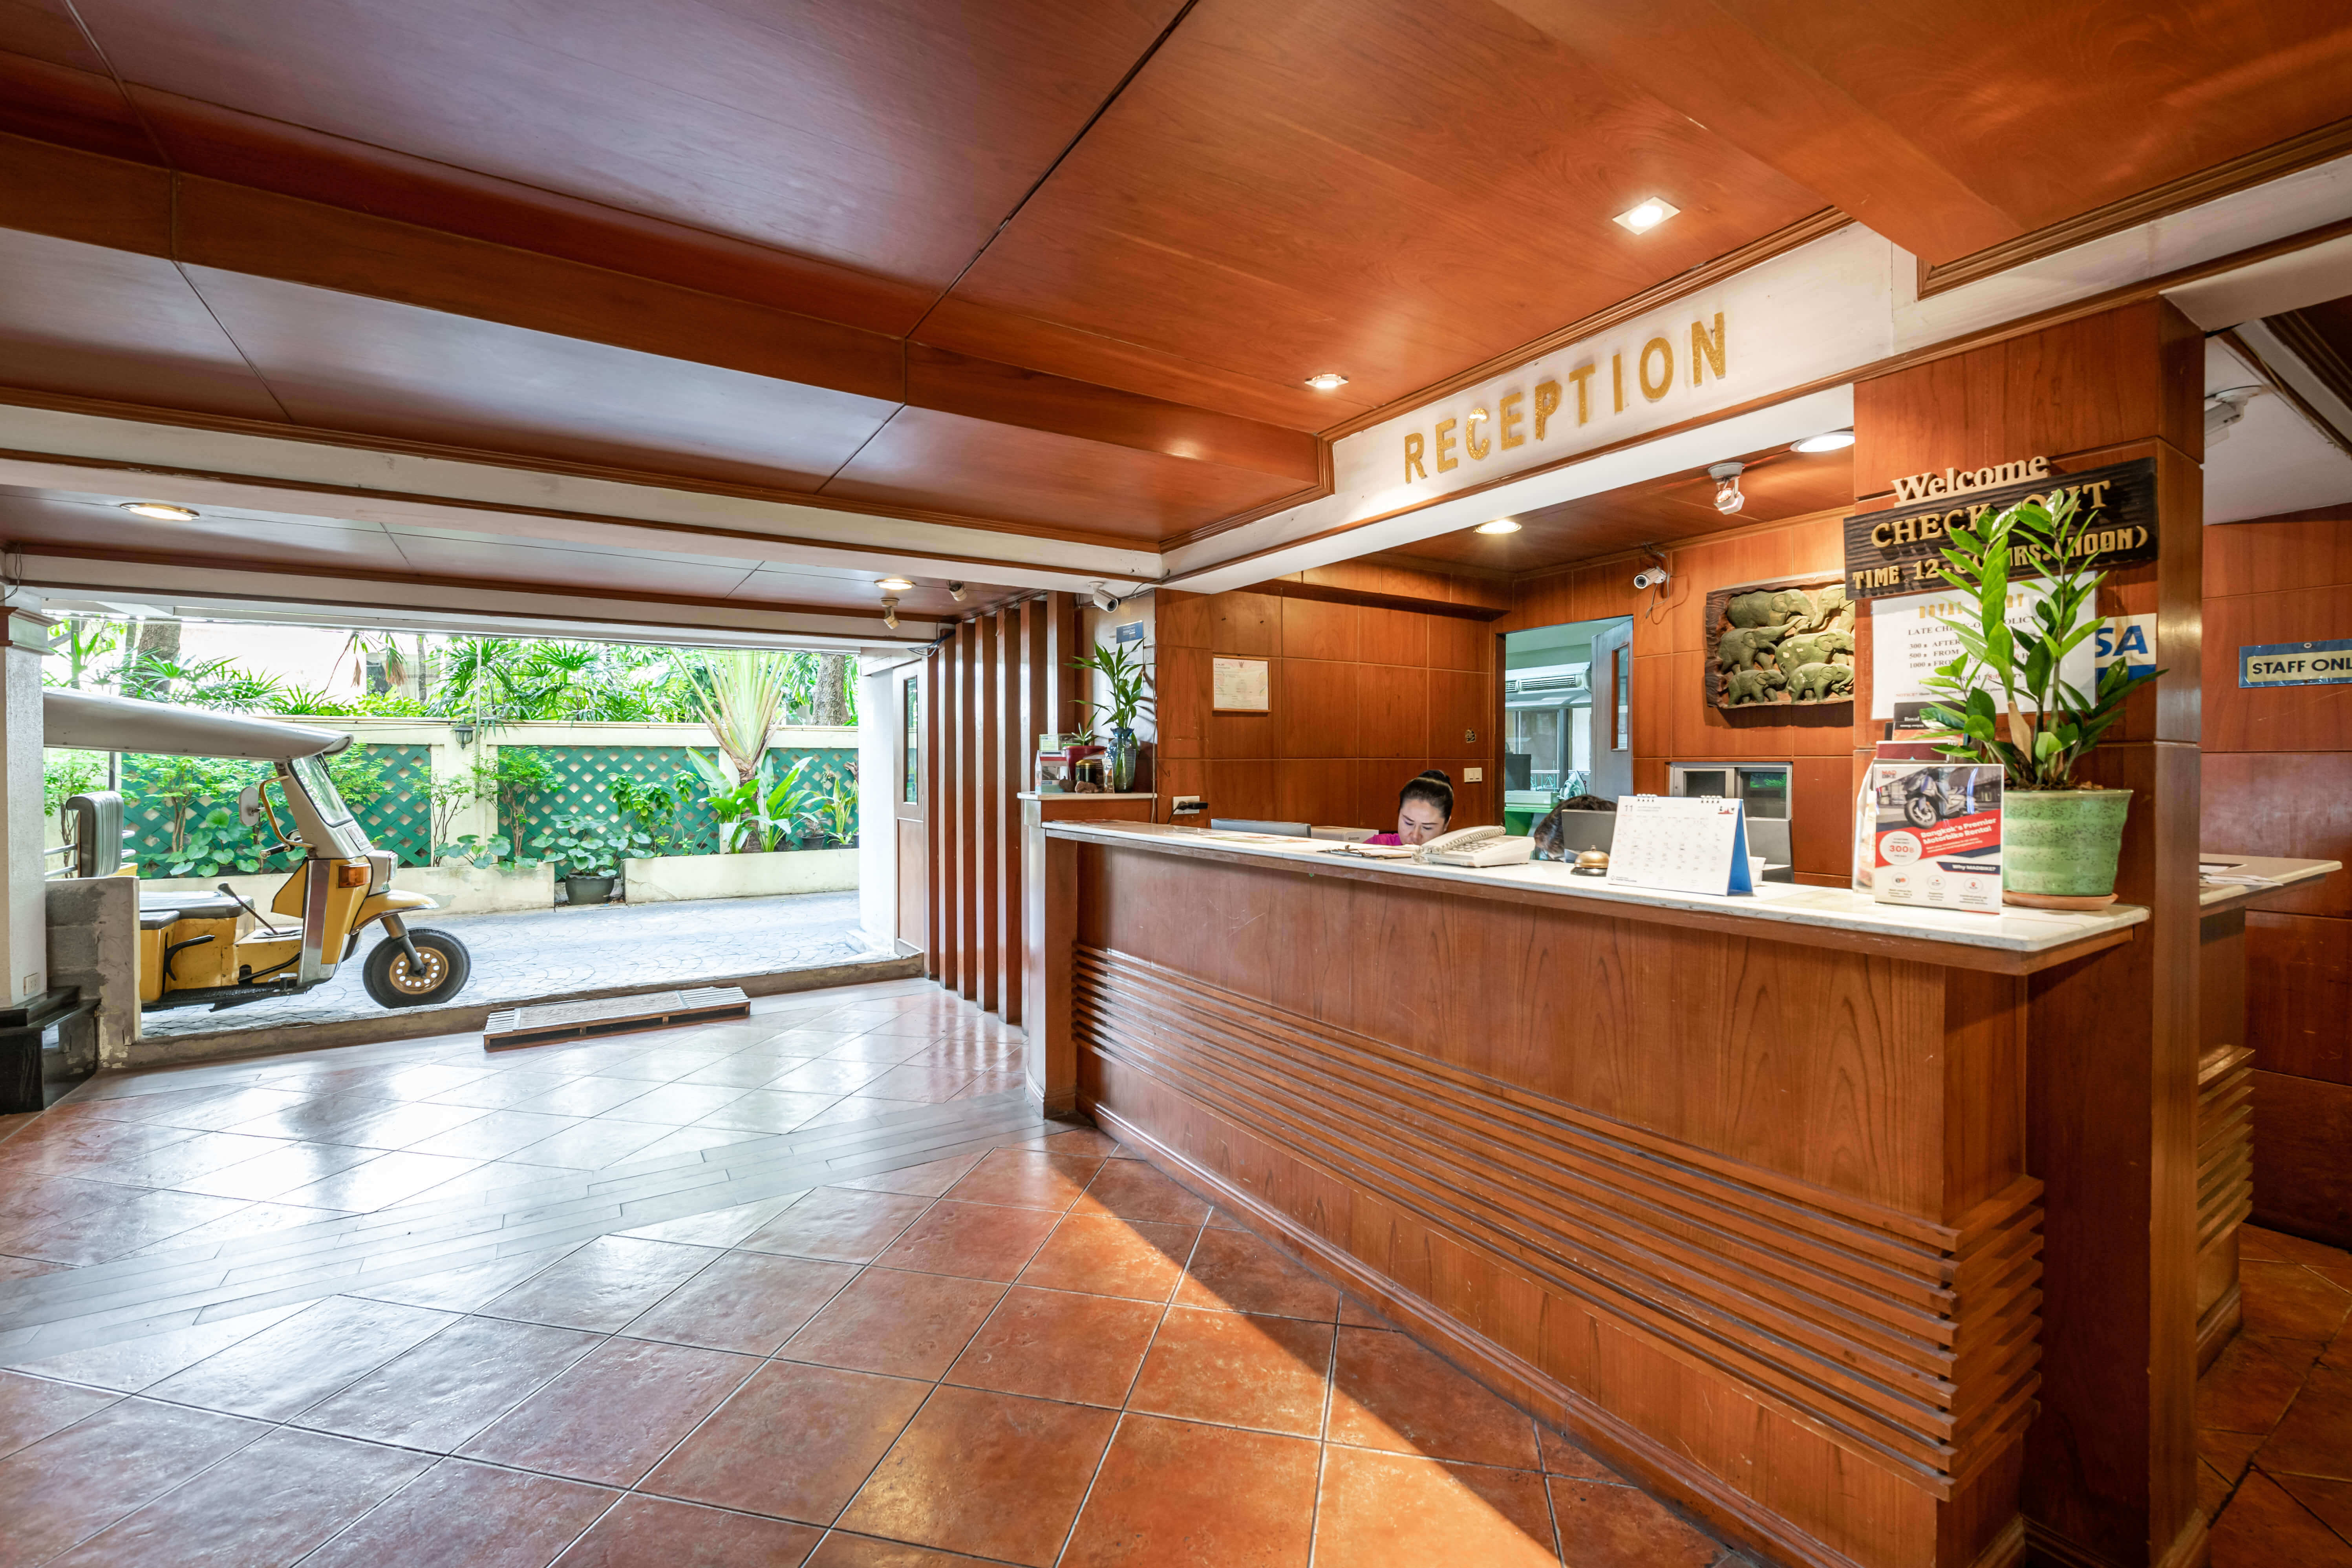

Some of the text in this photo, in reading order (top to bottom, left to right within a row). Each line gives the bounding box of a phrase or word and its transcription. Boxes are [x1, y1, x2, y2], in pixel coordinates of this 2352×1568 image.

[1404, 312, 1725, 484] RECEPTION
[1891, 456, 2050, 502] Welcome
[1871, 503, 1992, 548] CHECK
[1852, 565, 1900, 589] TIME
[2004, 615, 2037, 625] OLICY
[2252, 660, 2306, 674] STAFF
[1920, 818, 1997, 838] Bangkok's Premier
[1922, 832, 1964, 844] Motorbike
[1964, 826, 1992, 836] Rental
